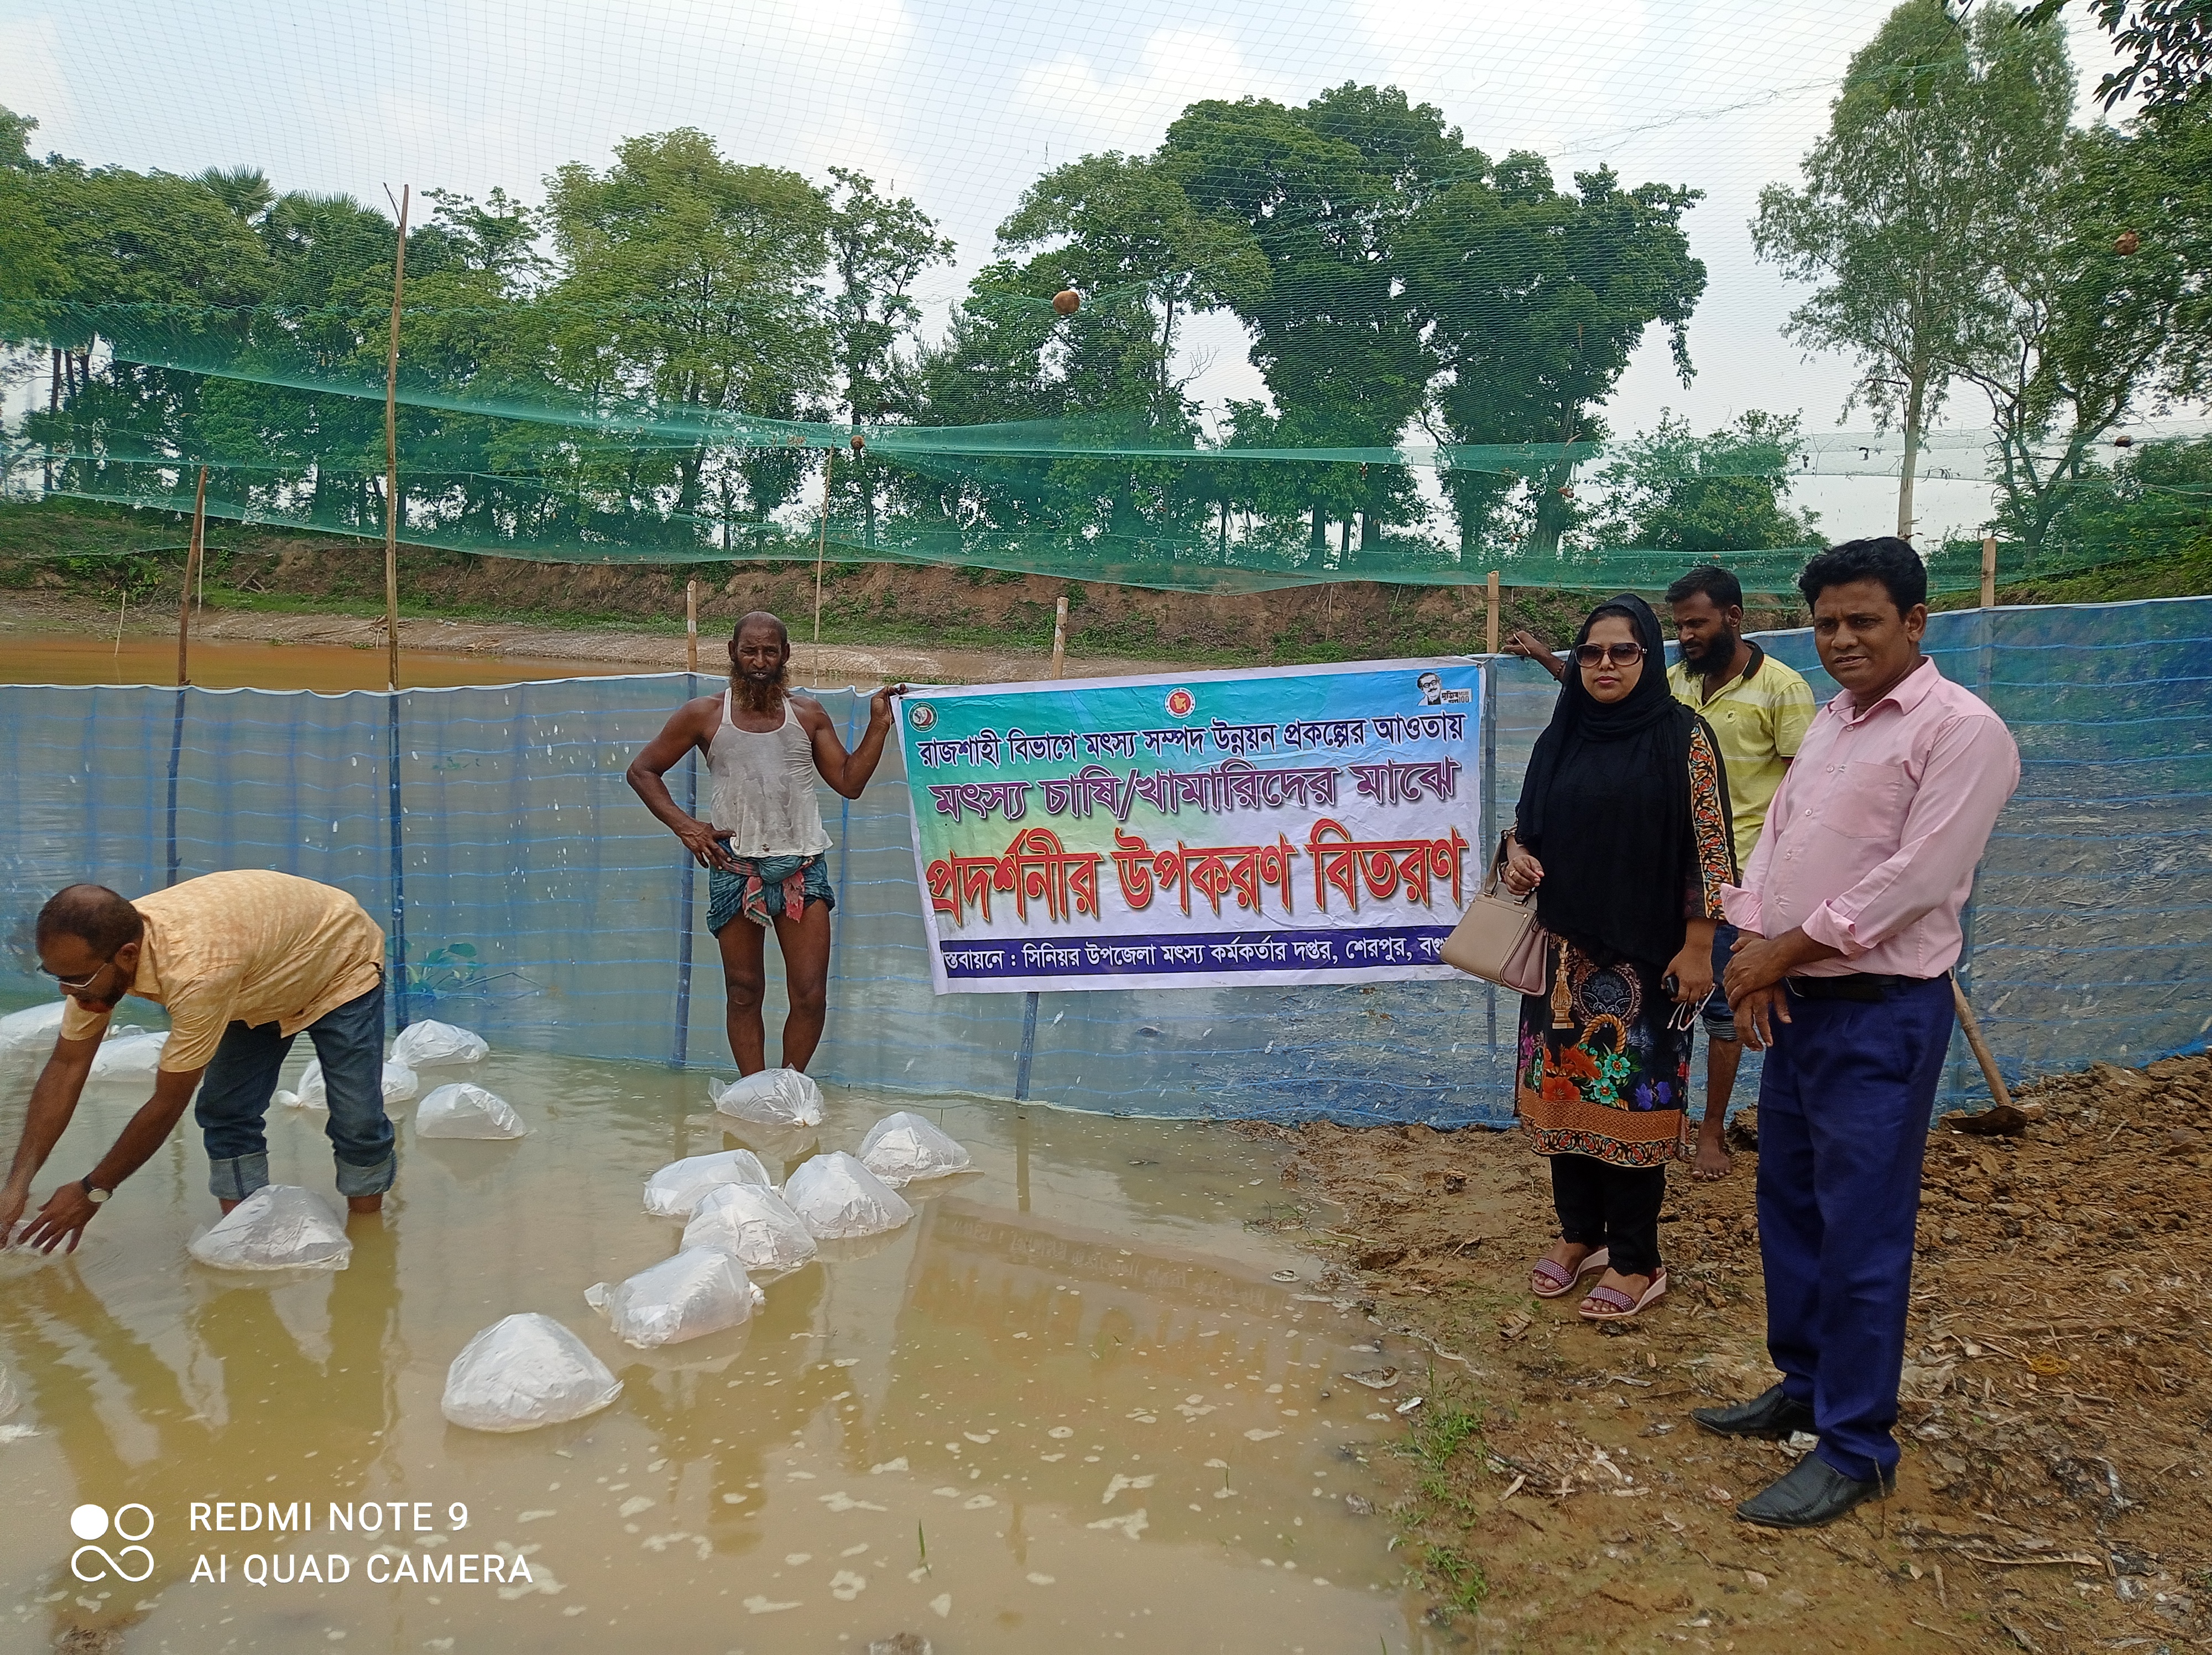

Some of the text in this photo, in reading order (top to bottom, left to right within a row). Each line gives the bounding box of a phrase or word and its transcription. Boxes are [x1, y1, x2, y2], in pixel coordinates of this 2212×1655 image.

[916, 711, 1465, 769] রাজশাহী বিভাগে মৎস্য সম্পদ উন্নয়ন প্রকল্পের আওতায়
[927, 755, 1462, 821] মৎস্য চাষি/খামারিদের মাঝে
[926, 818, 1469, 927] প্রদর্শনীর উপকরণ বিতরণ
[942, 949, 1005, 970] স্তবায়নে
[1021, 942, 1081, 969] সিনিয়র
[1084, 941, 1156, 966] উপজেলা
[1160, 945, 1206, 965] মৎস্য
[1210, 935, 1287, 964] কর্মকর্তার
[1293, 941, 1338, 965] দপ্তর,
[1345, 936, 1412, 963] শেরপুর,
